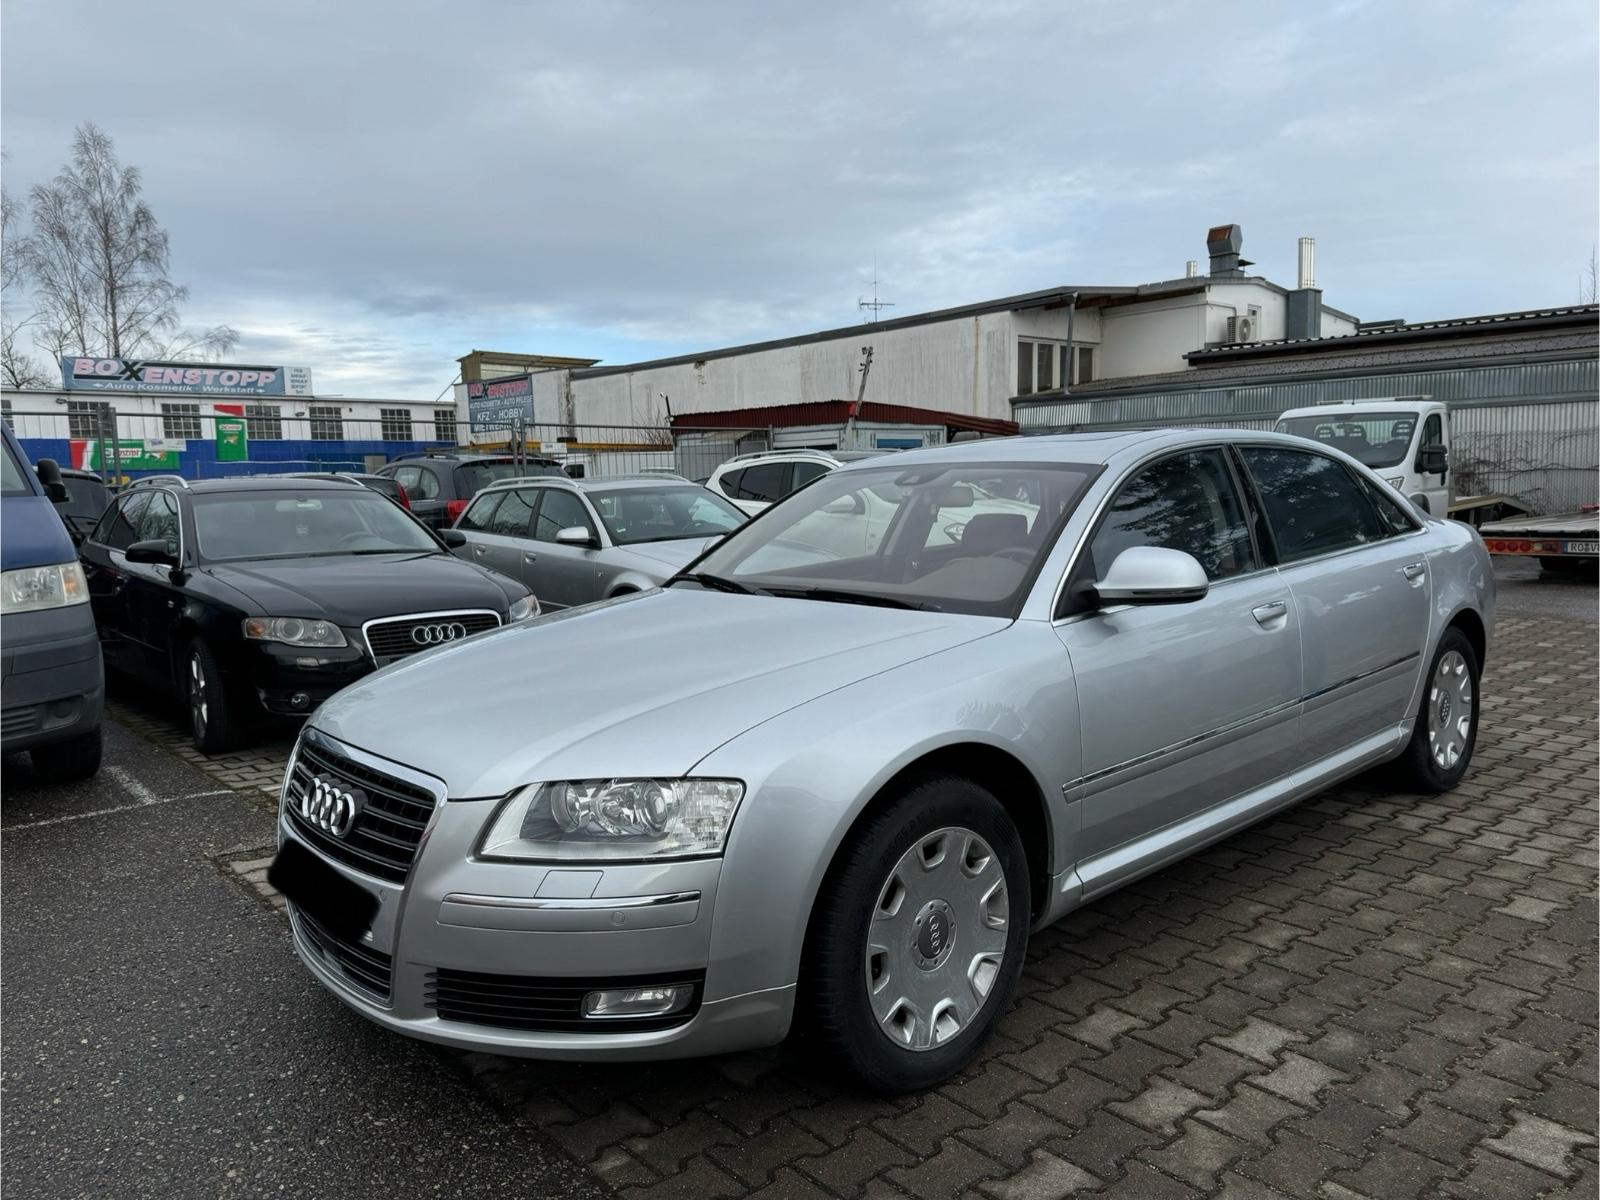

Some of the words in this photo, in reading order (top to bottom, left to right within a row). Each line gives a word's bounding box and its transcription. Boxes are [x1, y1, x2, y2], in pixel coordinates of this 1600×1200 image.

[73, 358, 276, 386] BOXENSTOPP
[105, 382, 134, 390] Auto
[137, 383, 193, 392] Kosmetik
[202, 385, 255, 393] Werkstatt
[477, 411, 490, 422] KFZ
[498, 408, 523, 419] HOBBY
[1571, 543, 1584, 551] RO
